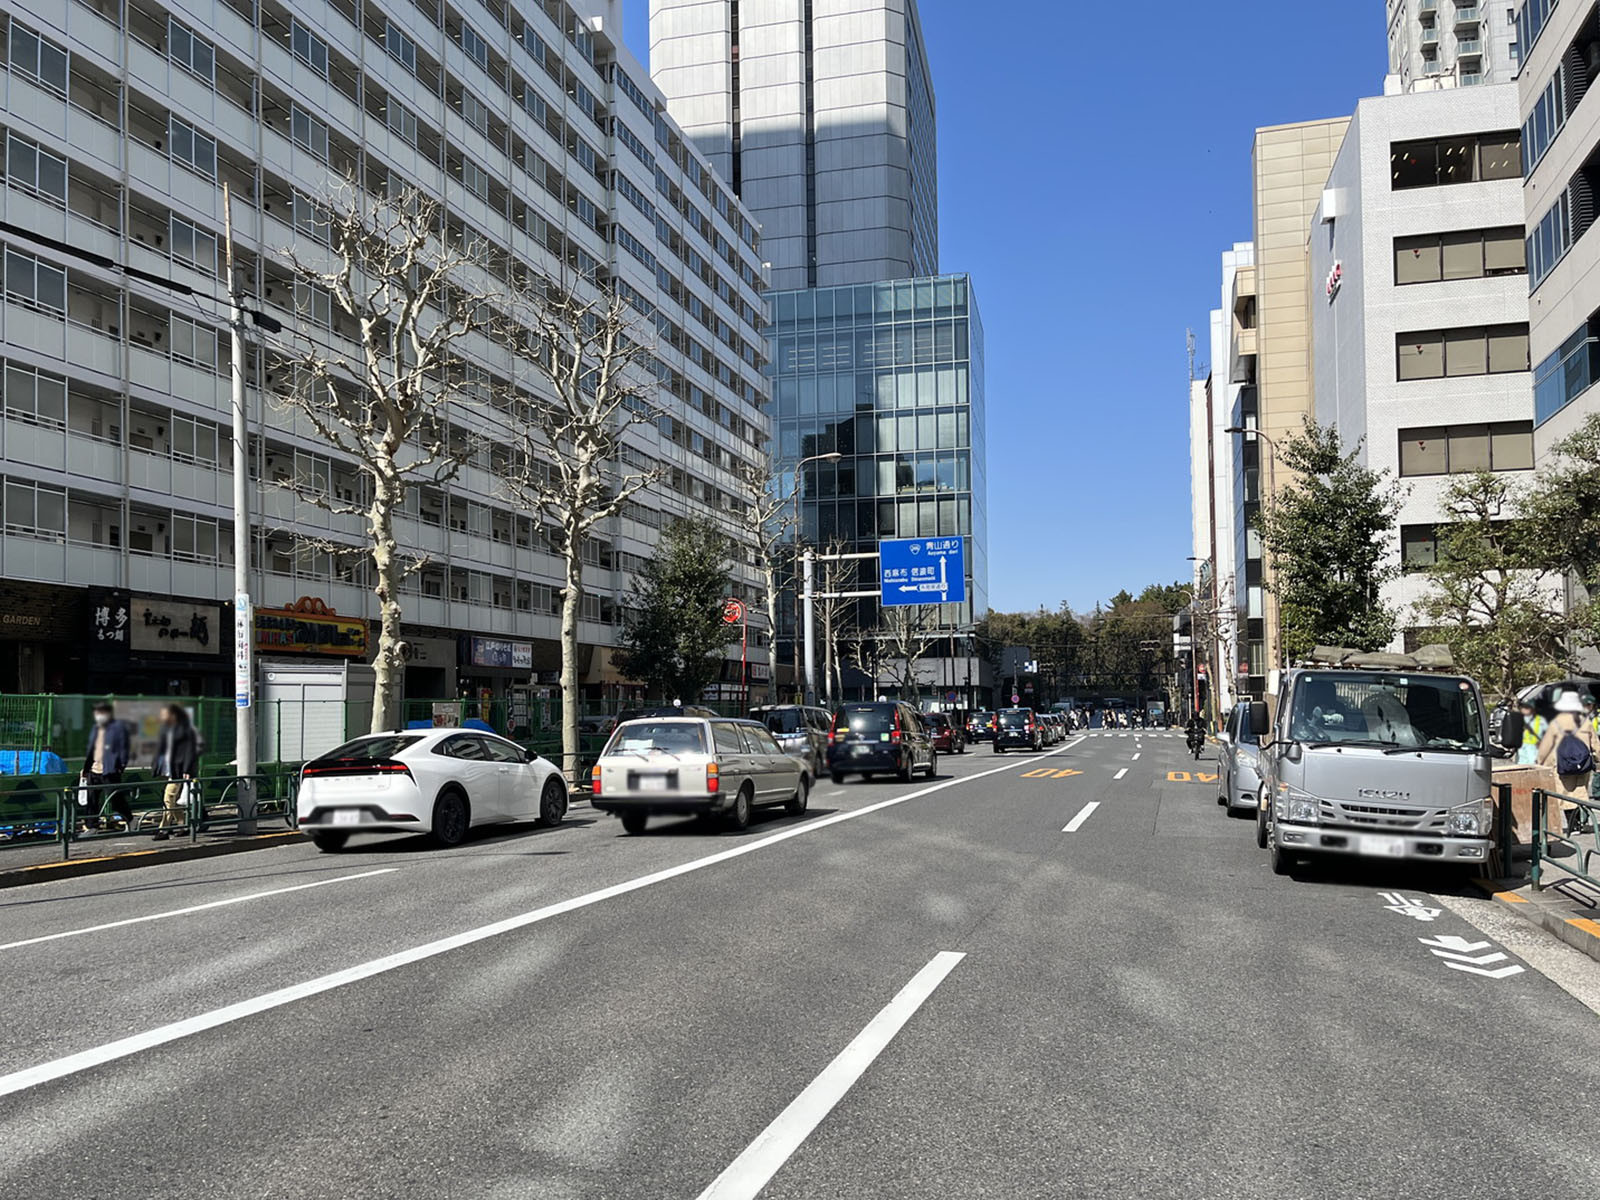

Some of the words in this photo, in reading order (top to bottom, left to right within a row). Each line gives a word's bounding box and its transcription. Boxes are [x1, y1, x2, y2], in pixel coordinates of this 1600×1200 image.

[926, 540, 959, 550] 青山通り
[884, 568, 908, 578] 西麻布
[911, 566, 935, 576] 信濃町
[2, 614, 41, 626] GARDEN
[95, 606, 128, 629] 博多
[1358, 788, 1411, 801] ISUZU
